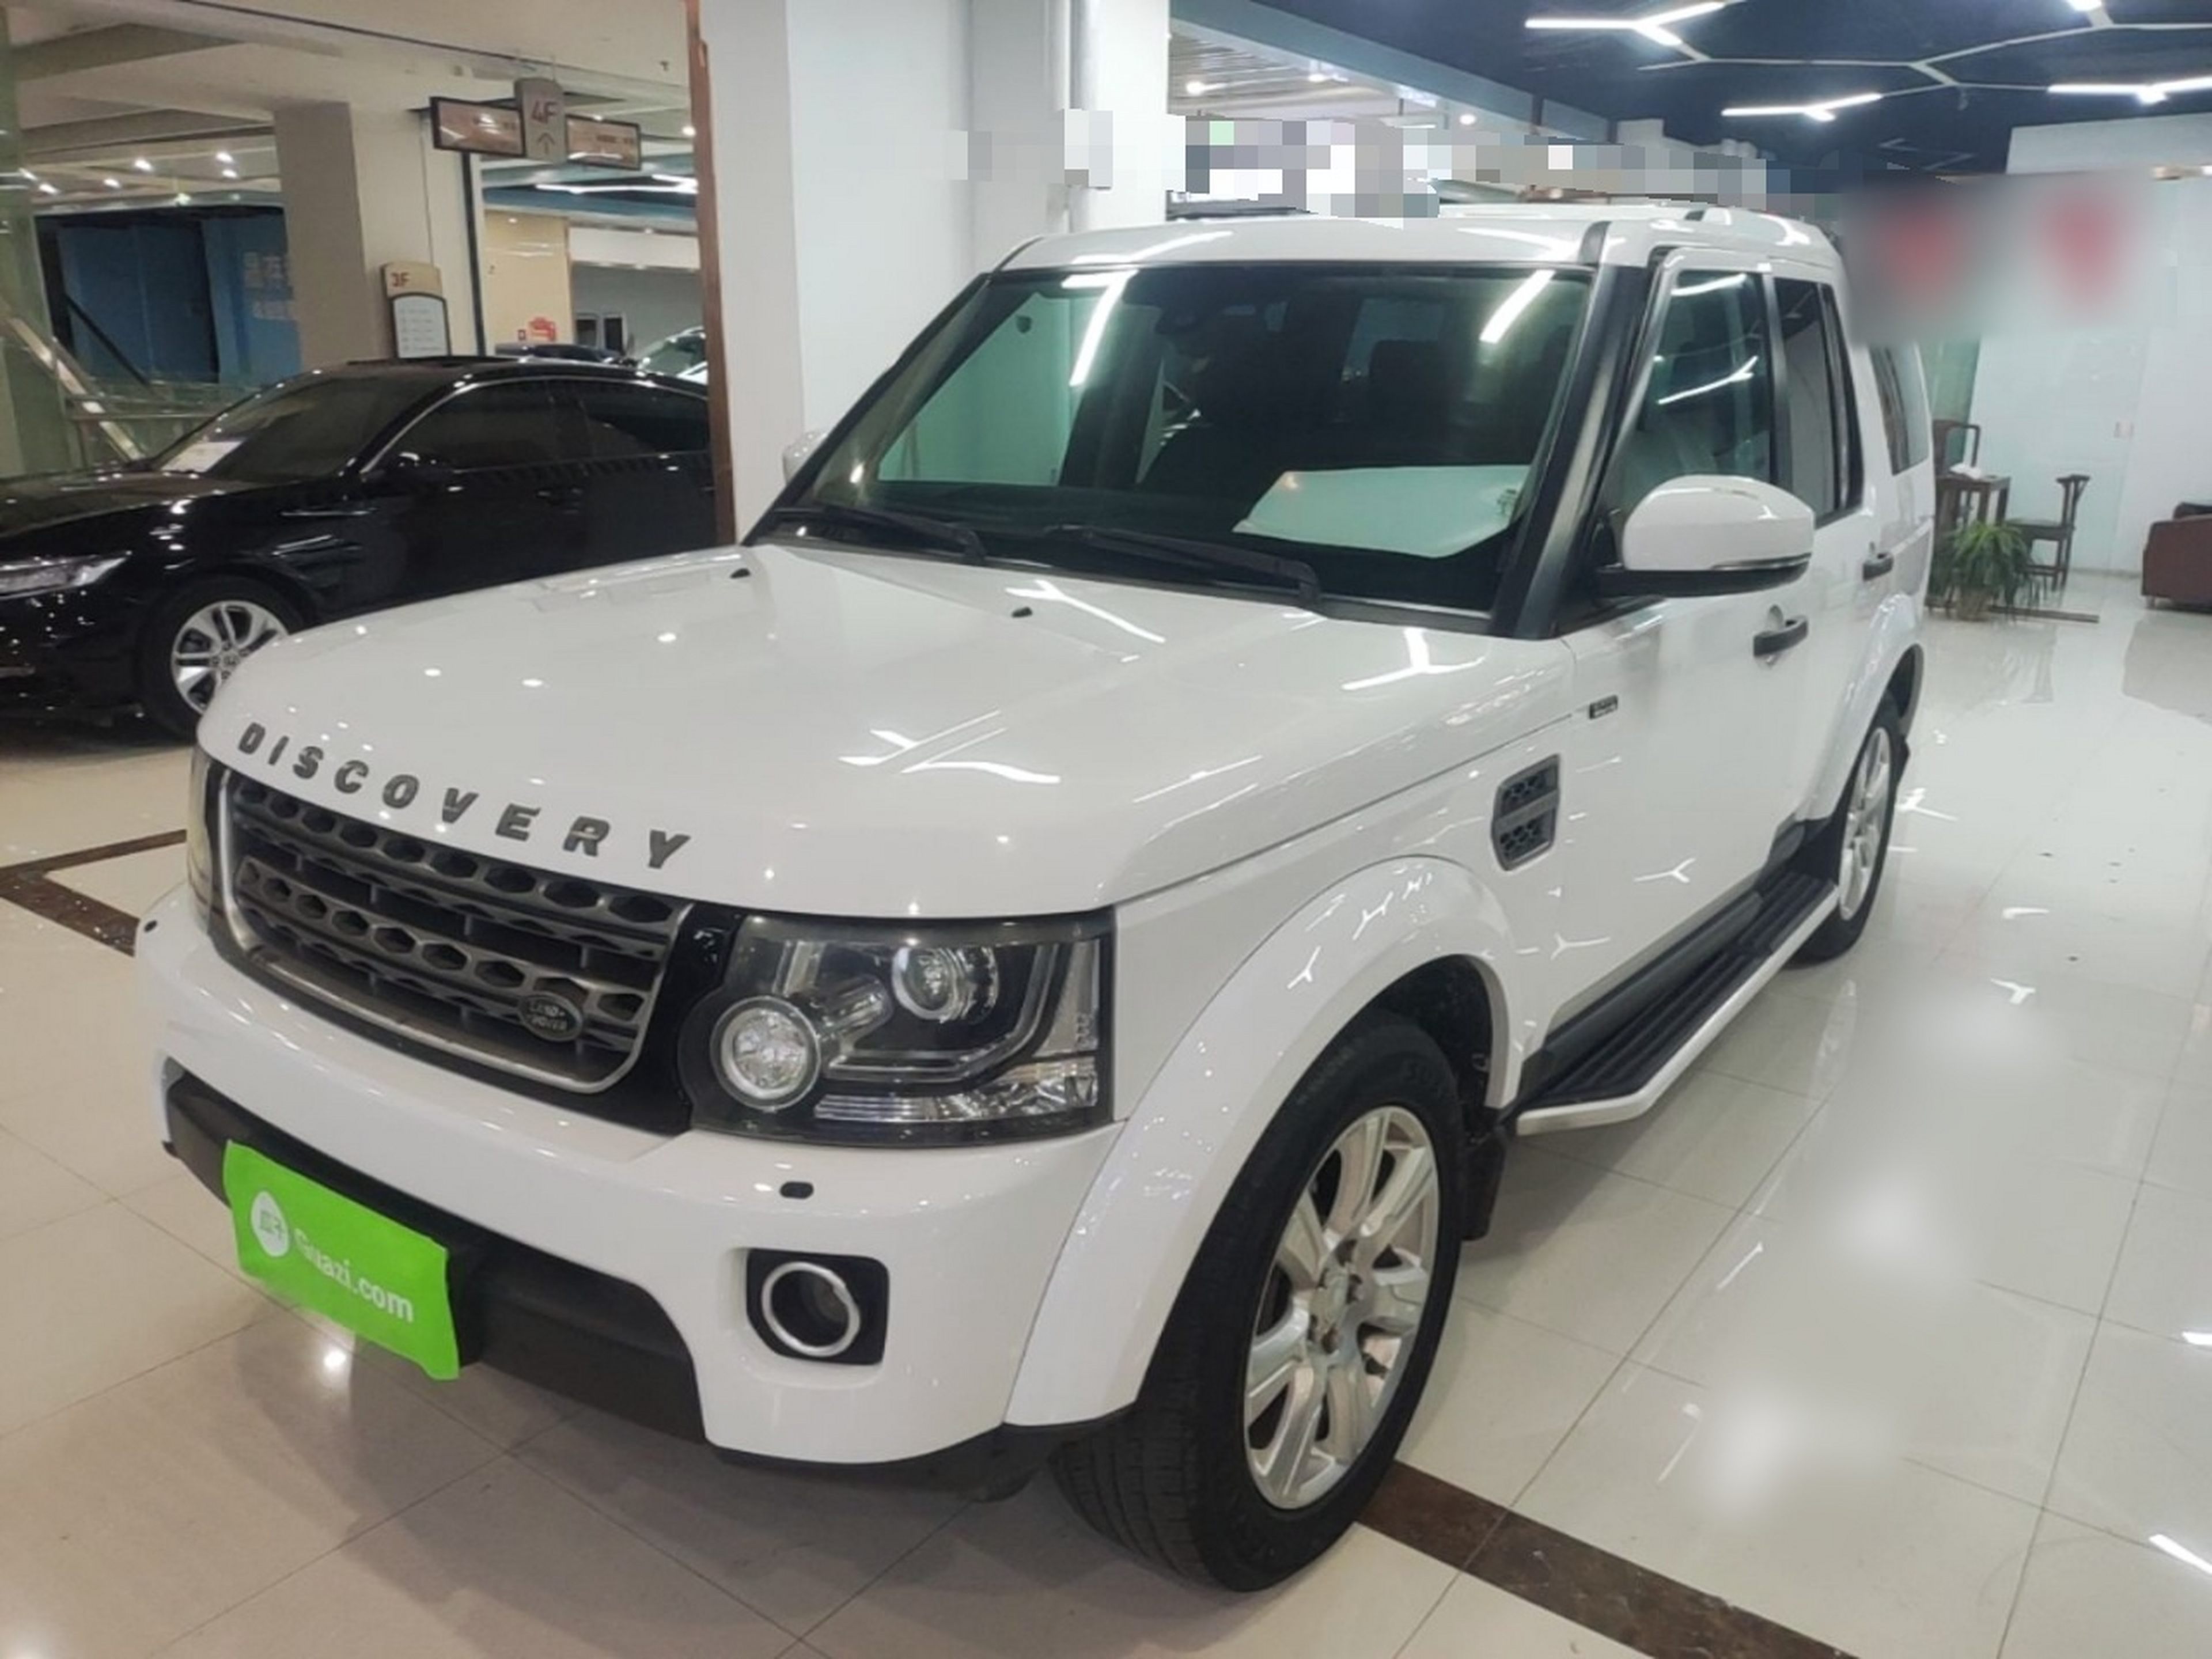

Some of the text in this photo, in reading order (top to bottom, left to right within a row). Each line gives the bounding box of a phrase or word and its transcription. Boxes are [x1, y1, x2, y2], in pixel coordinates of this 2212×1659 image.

[531, 102, 558, 124] 4F
[236, 721, 693, 870] DISCOVERY
[294, 1228, 414, 1323] Guazi.com
